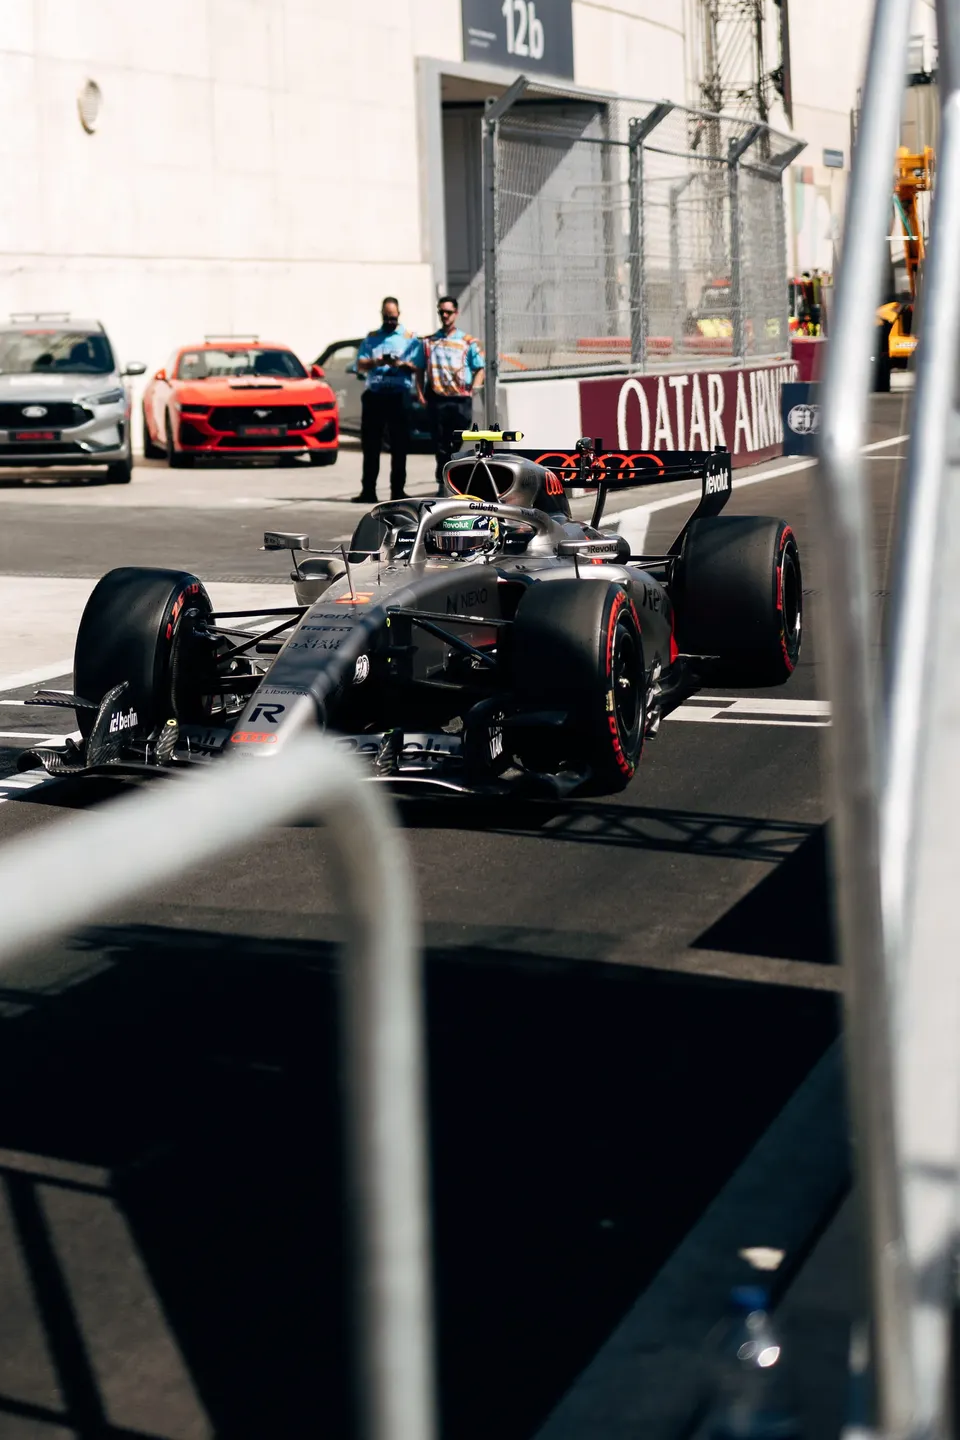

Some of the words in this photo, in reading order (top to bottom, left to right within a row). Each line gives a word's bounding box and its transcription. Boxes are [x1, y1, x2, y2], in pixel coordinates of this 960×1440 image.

[617, 373, 727, 452] QATAR
[468, 502, 499, 513] Gillette
[442, 521, 469, 529] Revolut
[460, 587, 488, 608] NEXO
[119, 706, 139, 730] berlin
[248, 703, 286, 723] R
